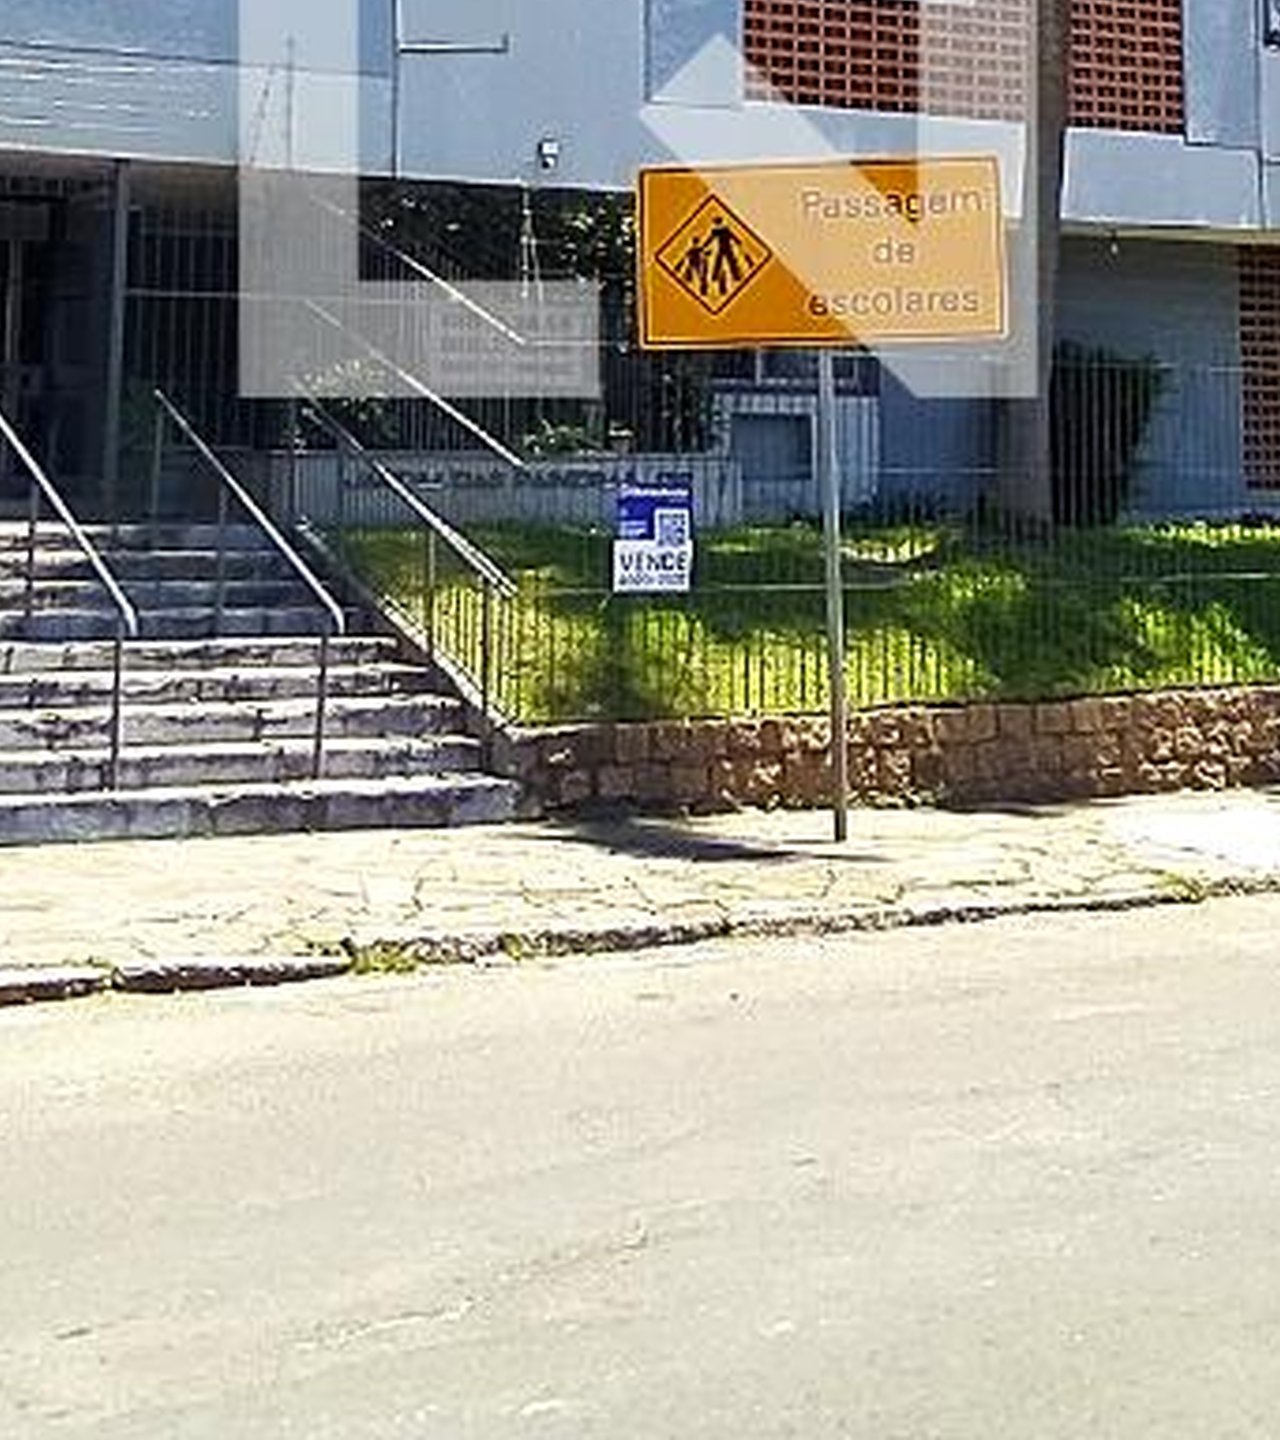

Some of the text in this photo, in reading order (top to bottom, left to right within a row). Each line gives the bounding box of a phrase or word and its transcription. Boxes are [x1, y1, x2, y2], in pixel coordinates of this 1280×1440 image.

[801, 188, 982, 223] Passagem
[873, 236, 915, 263] de
[808, 286, 980, 317] escolares
